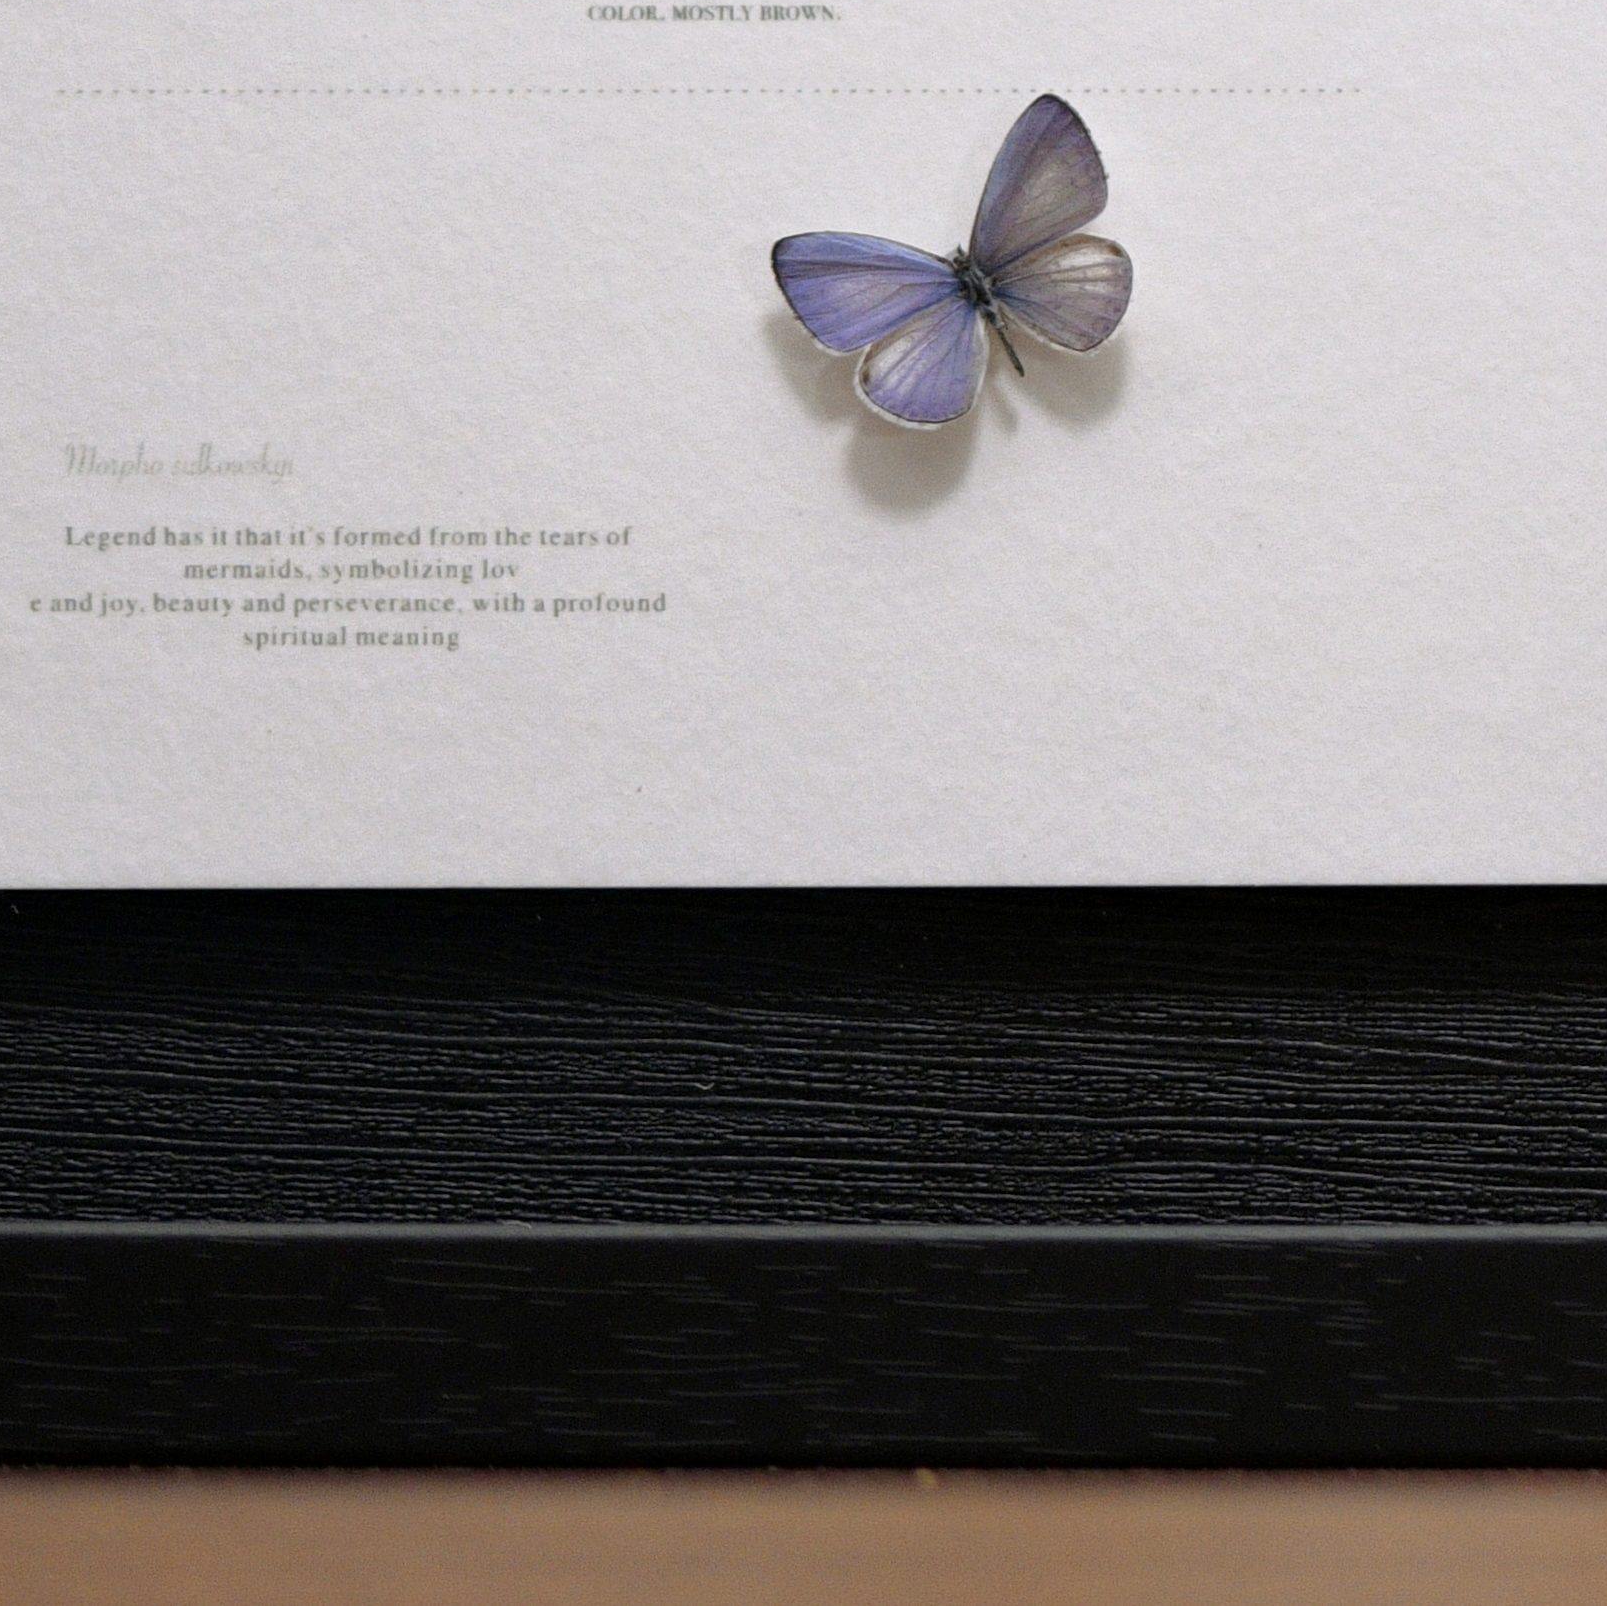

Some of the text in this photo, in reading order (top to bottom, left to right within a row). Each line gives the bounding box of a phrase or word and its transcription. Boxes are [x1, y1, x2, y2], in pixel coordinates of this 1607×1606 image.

[671, 4, 752, 21] MOSTLY
[63, 525, 158, 551] Legend
[161, 525, 204, 546] has
[210, 525, 228, 546] it
[234, 525, 282, 546] that
[332, 525, 422, 546] formed
[428, 525, 488, 546] from
[493, 525, 532, 546] the
[538, 525, 600, 546] tears
[604, 525, 633, 546] of
[319, 559, 474, 584] symbolizing
[481, 559, 518, 579] lov
[28, 598, 42, 613] e
[49, 592, 94, 613] and
[151, 592, 233, 618] beauty
[242, 592, 286, 613] and
[472, 592, 526, 613] with
[551, 592, 668, 618] profound
[242, 626, 460, 652] spiritual meaning
